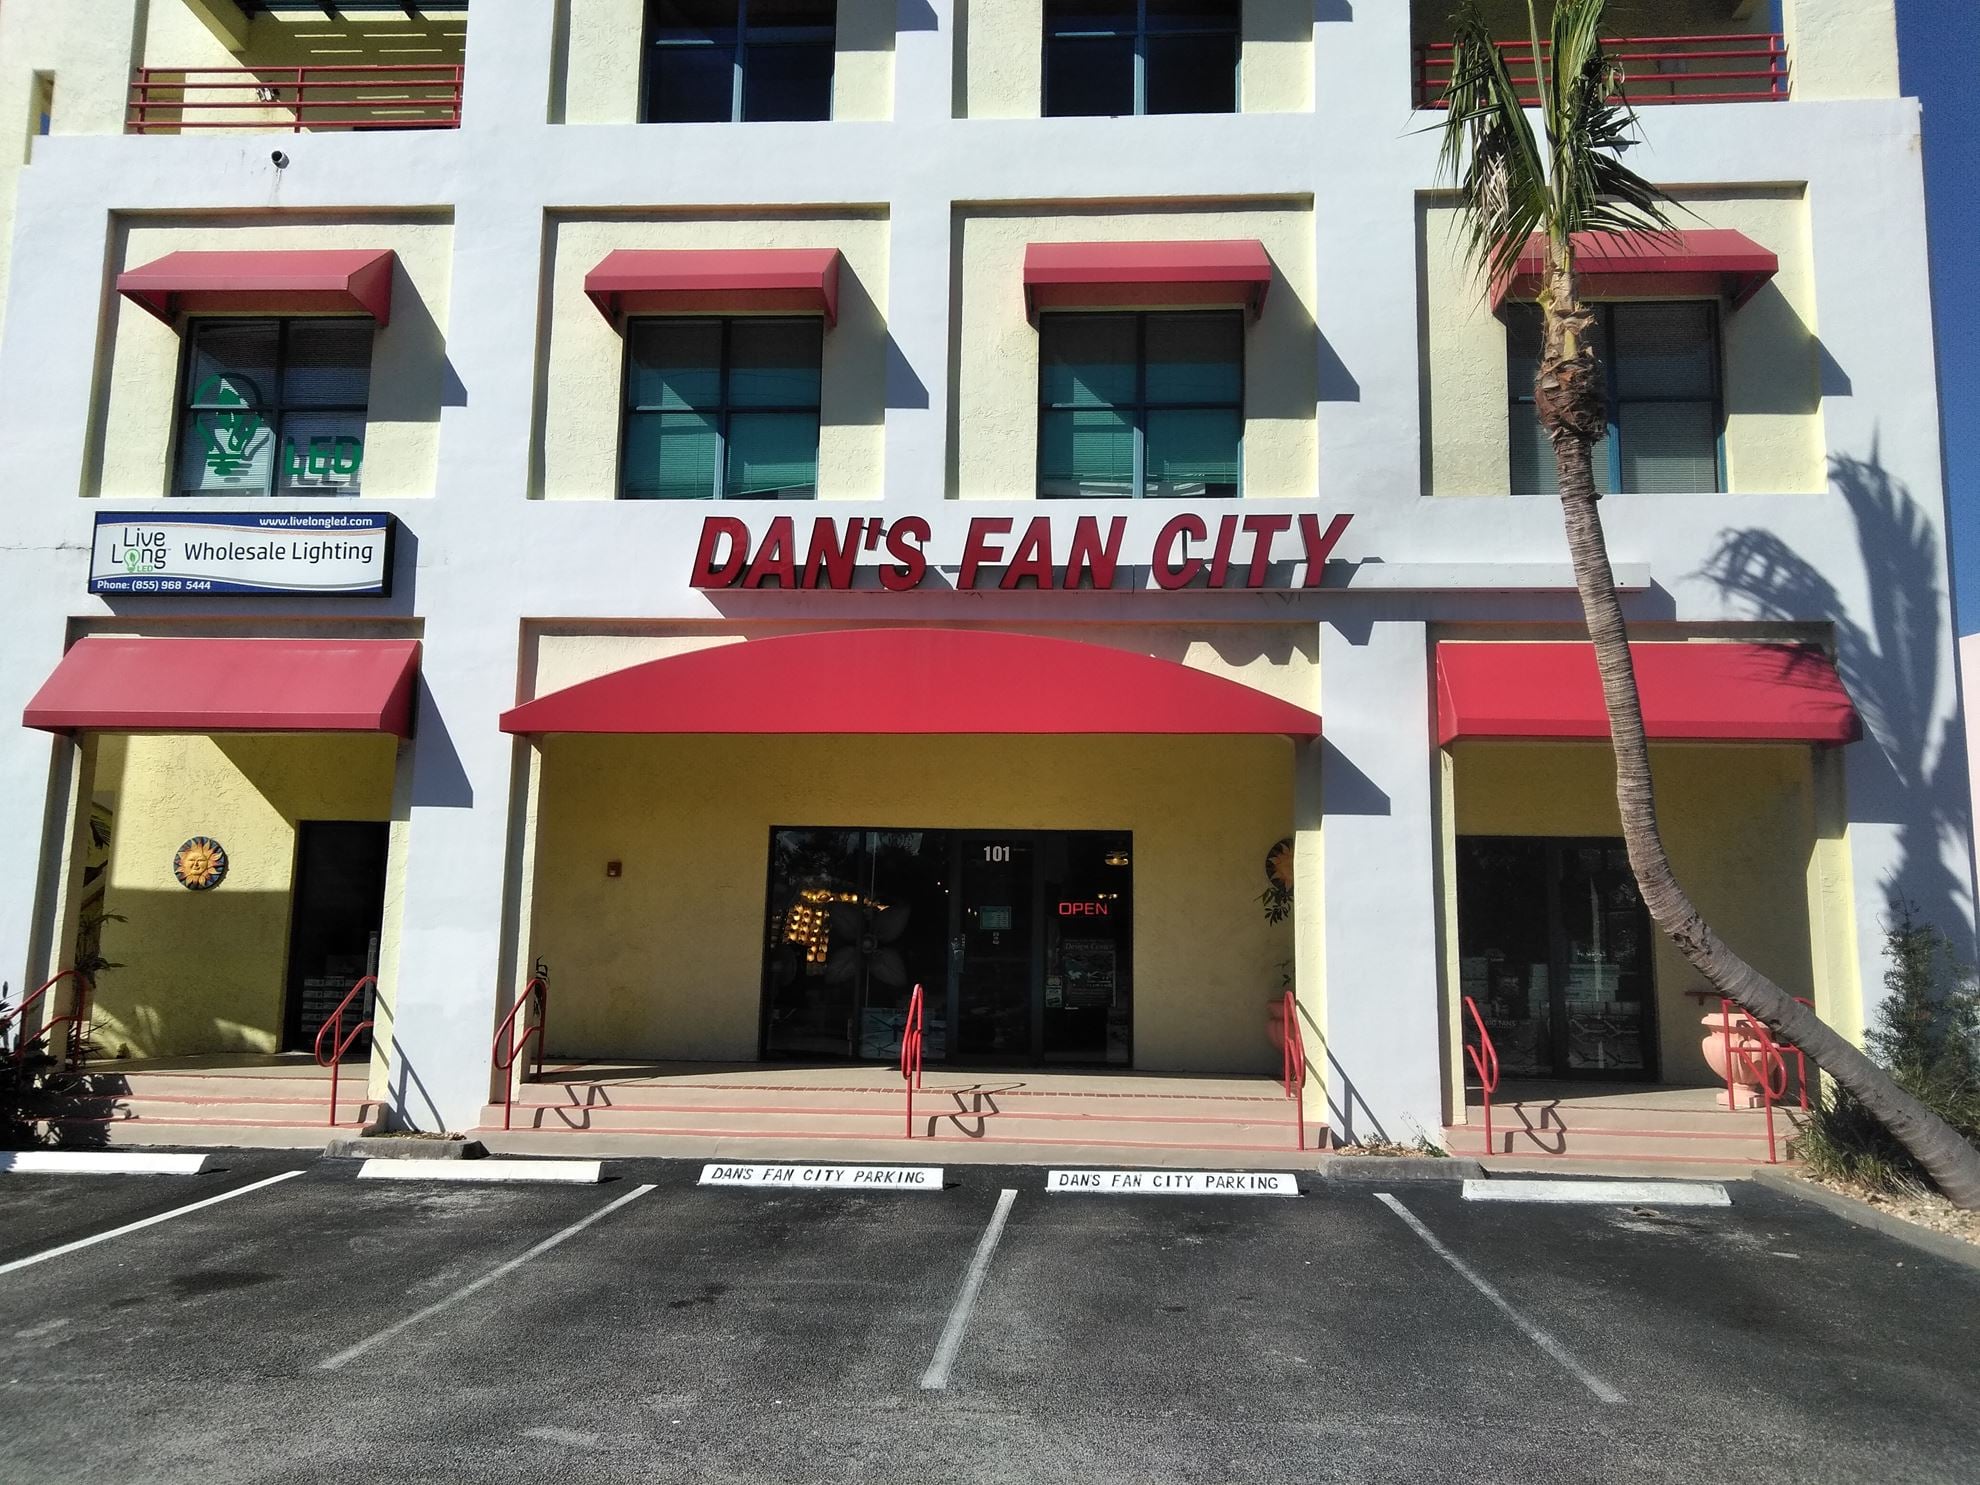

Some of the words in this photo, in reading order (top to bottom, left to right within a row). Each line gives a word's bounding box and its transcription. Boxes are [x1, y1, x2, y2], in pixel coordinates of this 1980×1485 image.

[284, 435, 362, 475] LED
[259, 516, 373, 528] www.livelongled.com
[124, 527, 165, 547] Live
[184, 542, 286, 561] Wholesale
[292, 542, 373, 563] Lighting
[689, 516, 932, 590] DAN'S
[956, 516, 1128, 590] FAN
[1152, 513, 1355, 590] CITY
[97, 580, 130, 589] Phone:
[132, 580, 159, 591] (855)
[161, 581, 182, 589] 968
[185, 581, 211, 590] 5444
[983, 846, 1010, 862] 101
[1059, 902, 1108, 915] OPEN
[762, 1168, 795, 1181] FAN
[803, 1169, 845, 1182] CITY
[853, 1170, 926, 1184] PARKING
[1111, 1174, 1142, 1188] FAN
[1152, 1175, 1194, 1189] CITY
[1205, 1175, 1279, 1190] PARKING
